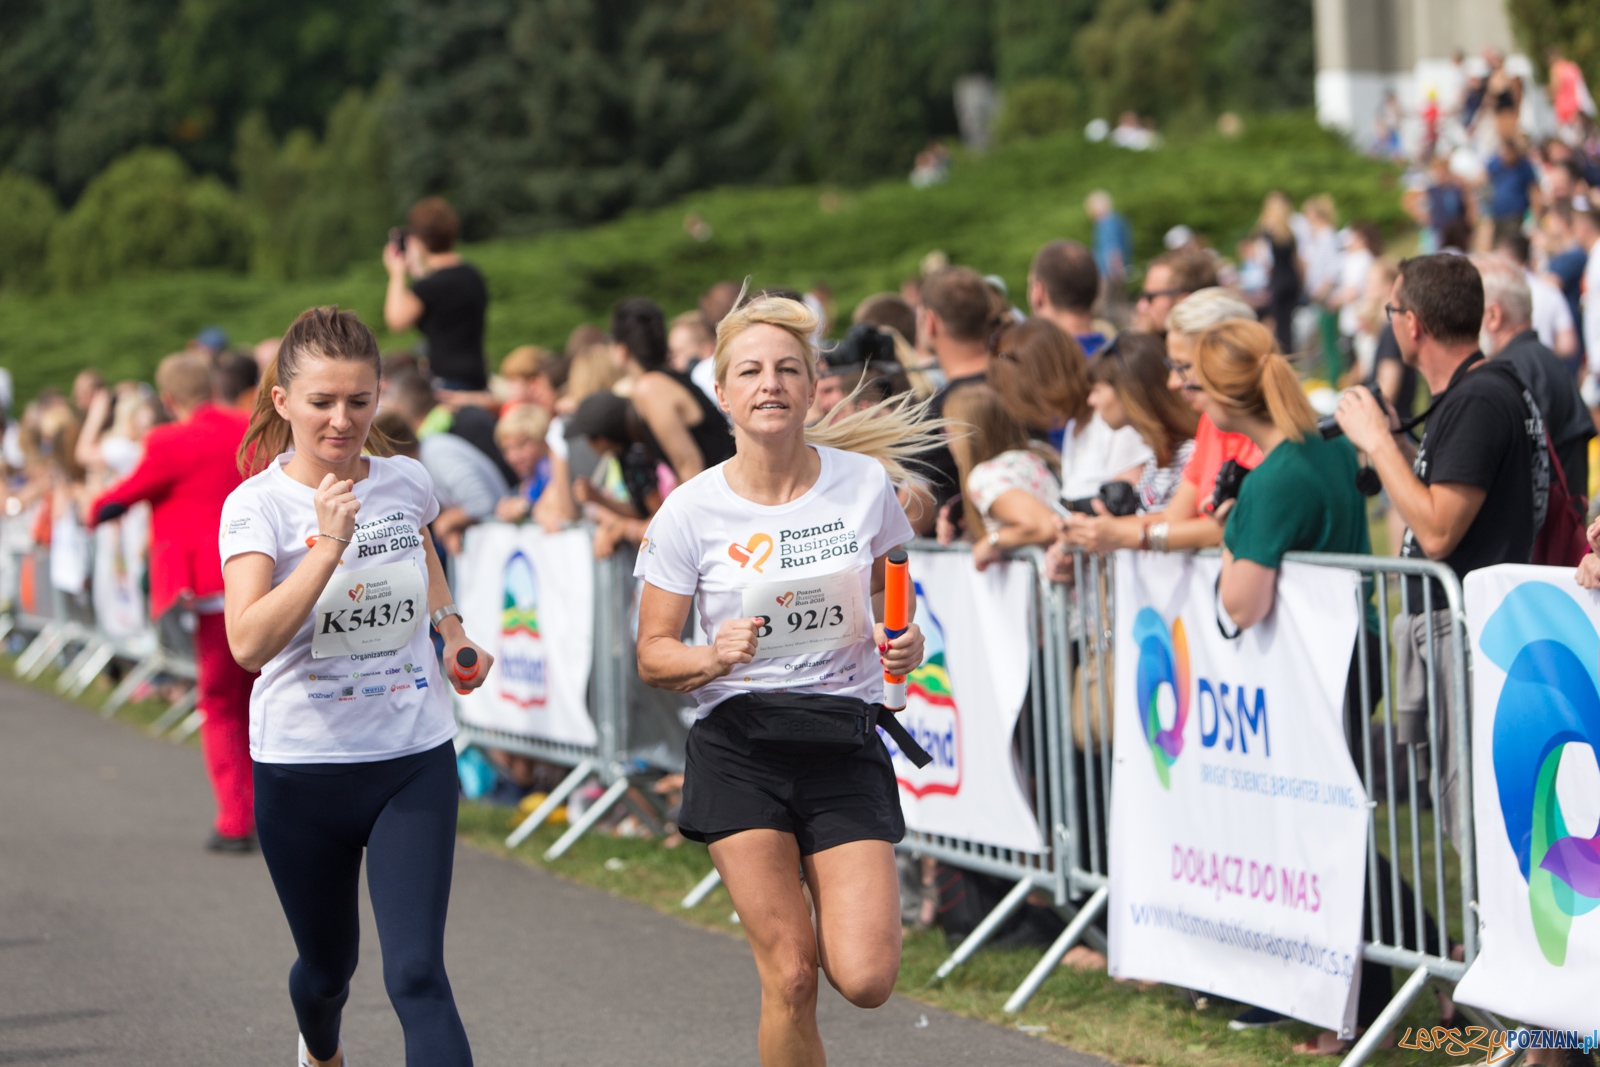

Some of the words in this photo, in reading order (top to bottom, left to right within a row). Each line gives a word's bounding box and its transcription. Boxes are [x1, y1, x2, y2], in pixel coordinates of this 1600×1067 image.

[354, 511, 404, 533] Poznań
[780, 517, 844, 542] Poznań
[356, 524, 413, 543] Business
[780, 530, 856, 556] Business
[358, 542, 388, 558] Run
[390, 536, 419, 552] 2016
[781, 555, 817, 569] Run
[821, 541, 859, 560] 2016
[366, 580, 388, 589] Poznań
[366, 586, 391, 595] Business
[796, 588, 821, 596] Poznań
[365, 593, 378, 601] Run
[378, 591, 392, 599] 2016
[796, 593, 825, 601] Business
[810, 597, 825, 605] 2016
[319, 599, 415, 635] K543/3
[755, 615, 773, 638] B
[787, 605, 844, 634] 92/3
[350, 650, 398, 661] Organizatorzy:
[385, 667, 401, 675] ciber
[1198, 677, 1270, 757] DSM
[1172, 844, 1244, 902] DOŁĄCZ
[1250, 860, 1276, 902] DO
[1281, 867, 1321, 912] NAS
